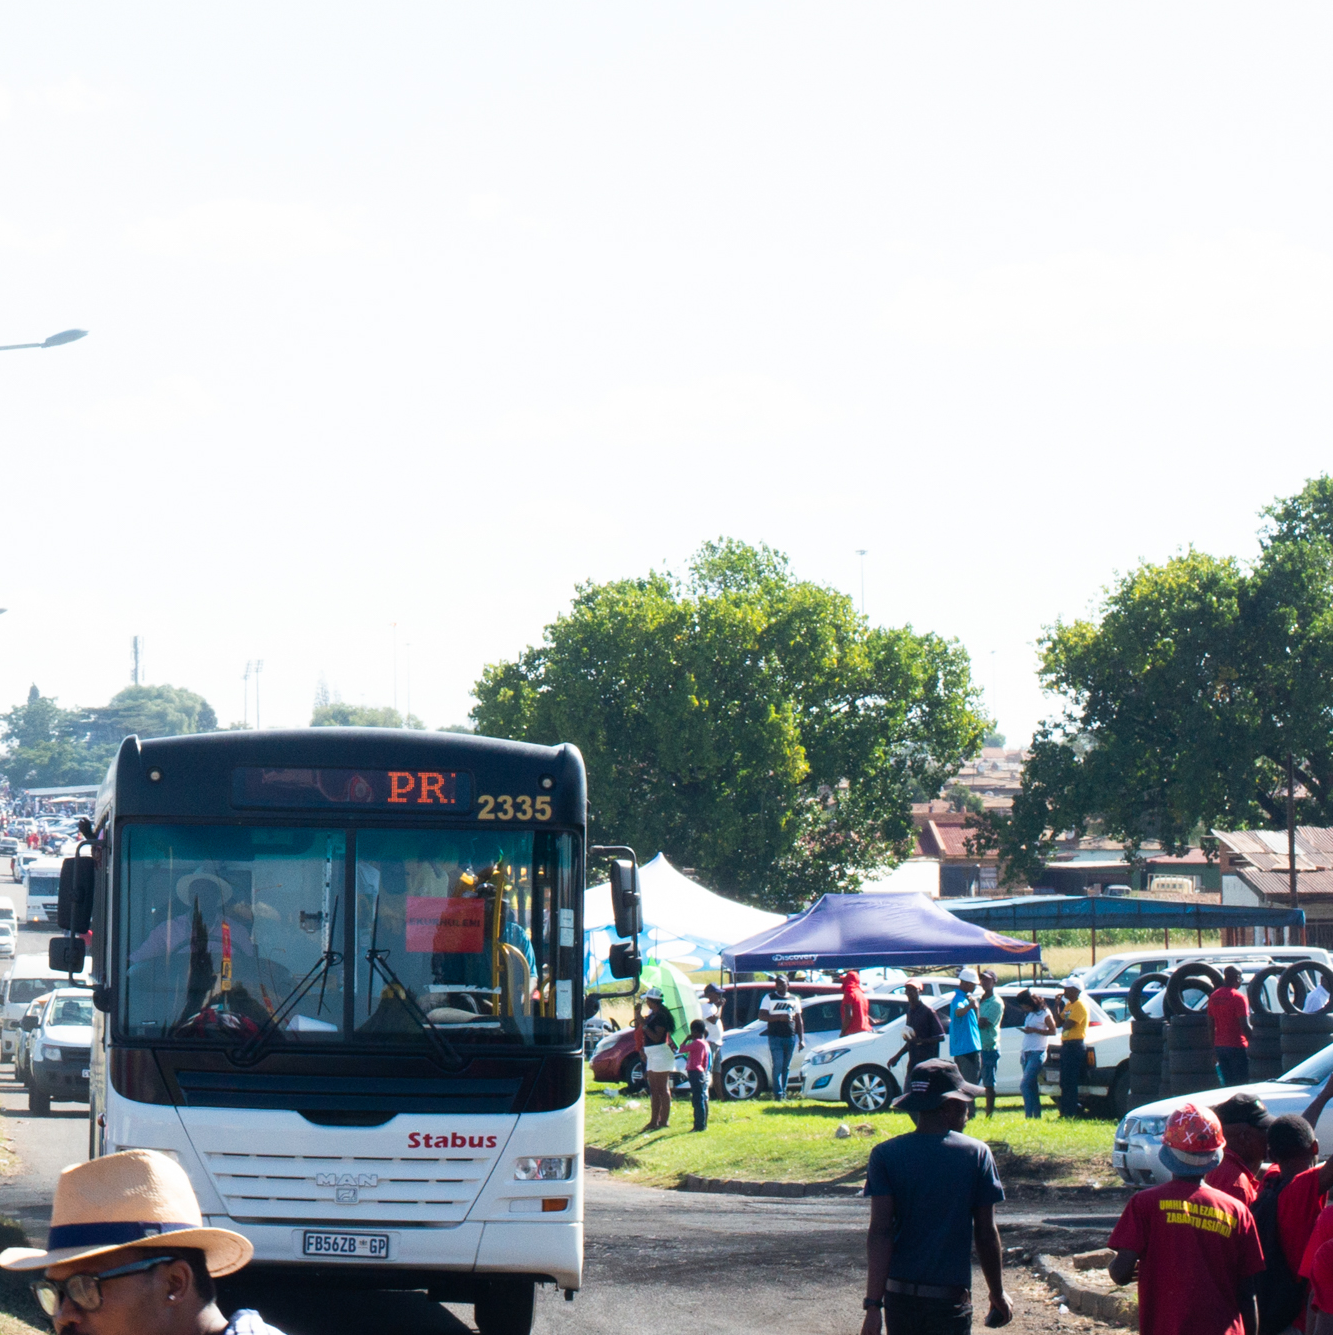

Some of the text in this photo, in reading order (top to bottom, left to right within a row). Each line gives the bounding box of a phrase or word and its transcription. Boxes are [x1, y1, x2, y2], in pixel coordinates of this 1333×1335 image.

[477, 795, 552, 821] 2335
[408, 1132, 497, 1149] Stabus
[316, 1173, 378, 1187] MAN
[307, 1236, 387, 1254] FB56ZB GP
